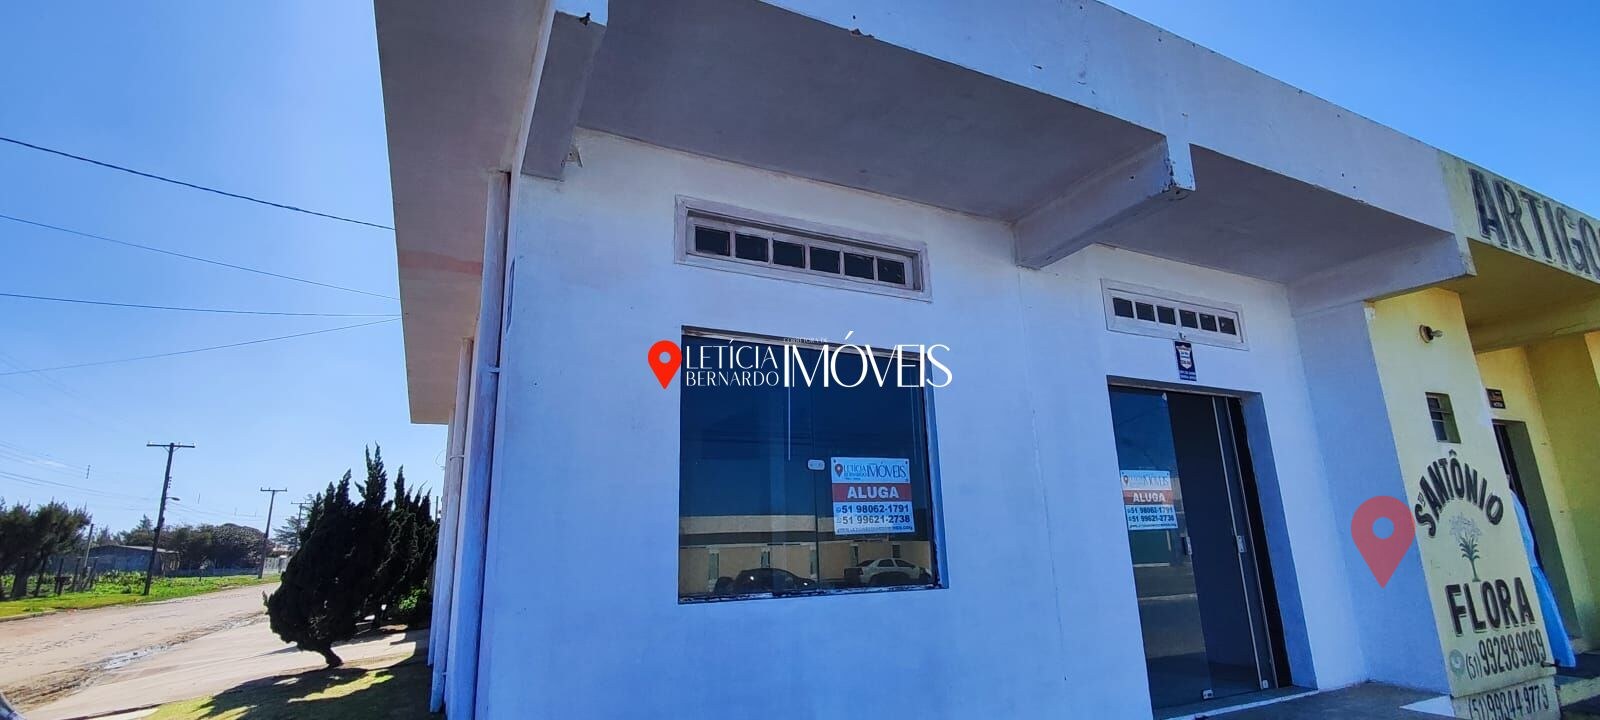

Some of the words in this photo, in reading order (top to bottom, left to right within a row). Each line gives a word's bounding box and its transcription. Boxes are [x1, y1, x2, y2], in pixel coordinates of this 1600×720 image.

[1468, 168, 1600, 280] ARTIGO
[847, 487, 899, 499] ALUGA
[1133, 492, 1166, 503] ALUGA
[841, 504, 853, 514] 51
[856, 504, 909, 514] 98062-1791
[842, 516, 853, 525] 51
[1445, 577, 1536, 637] FLORA
